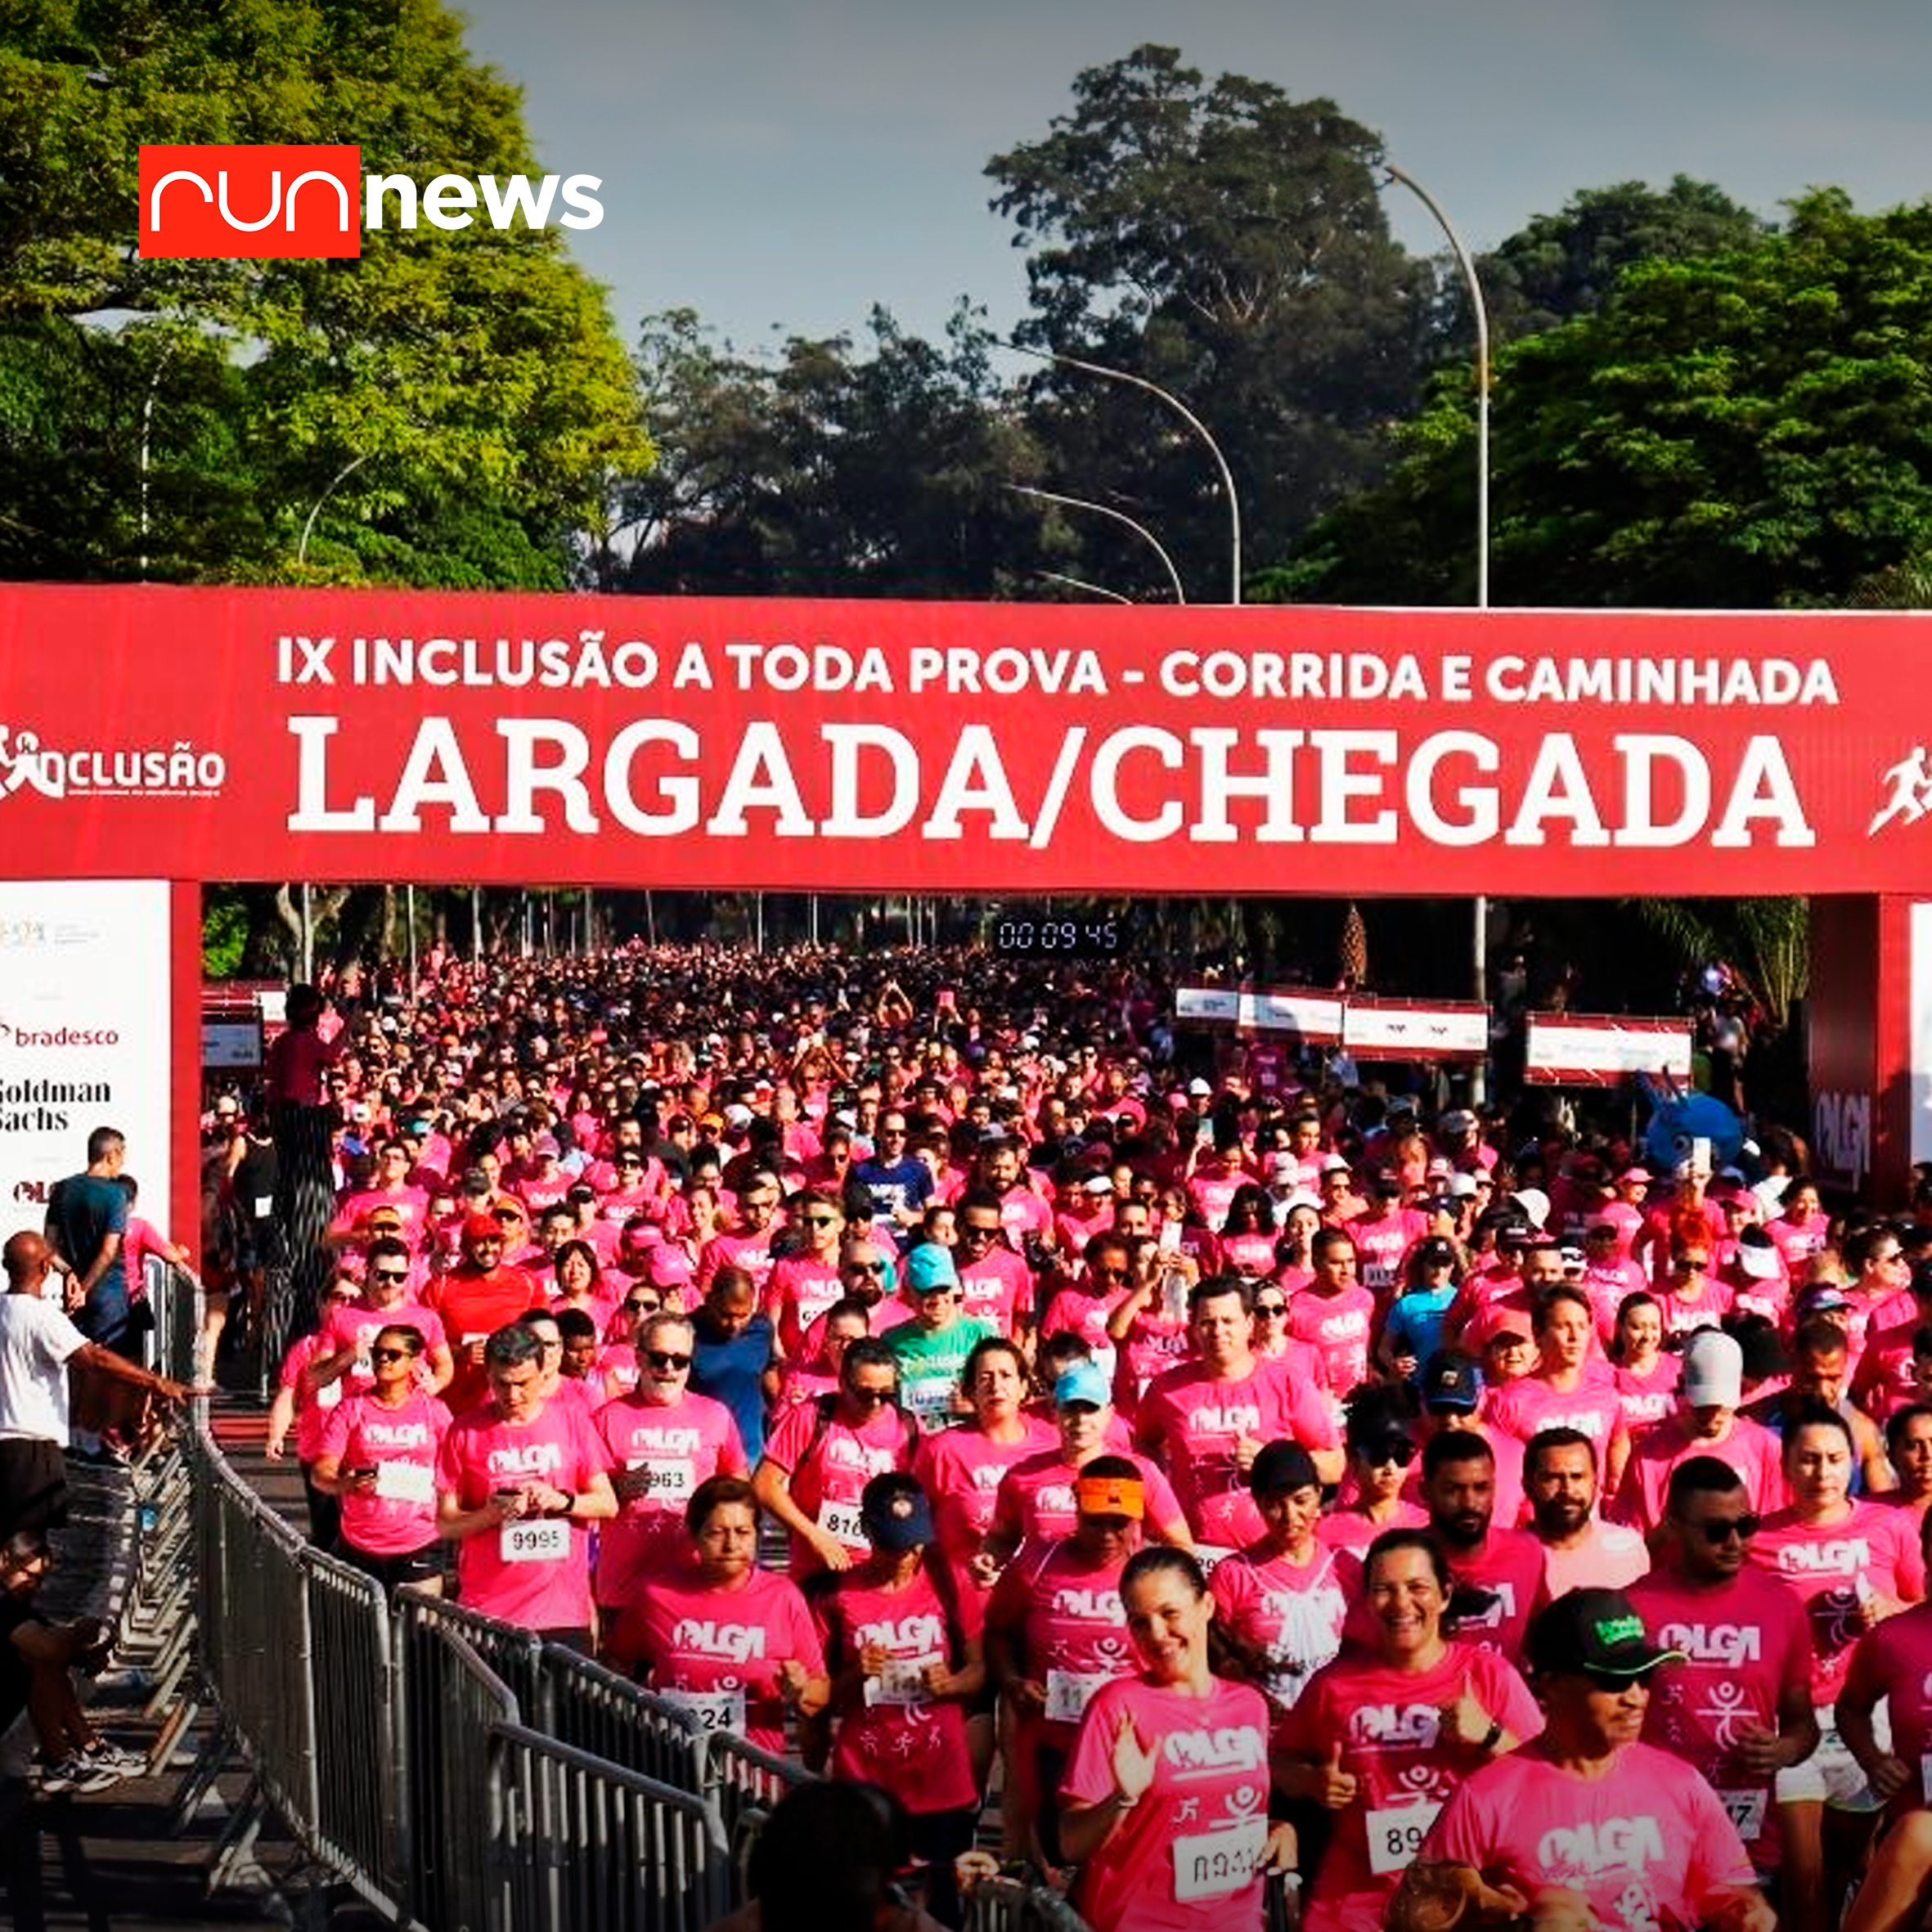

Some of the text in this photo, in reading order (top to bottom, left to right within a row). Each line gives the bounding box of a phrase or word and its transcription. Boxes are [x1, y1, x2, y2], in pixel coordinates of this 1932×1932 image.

[278, 636, 335, 684] IX
[353, 630, 658, 688] INCLUSÃO
[673, 643, 712, 689] A
[725, 644, 894, 693] TODA
[910, 647, 1108, 694] PROVA
[1160, 650, 1427, 700] CORRIDA
[1442, 655, 1472, 702] E
[1485, 655, 1840, 705] CAMINHADA
[287, 716, 1816, 850] LARGADA/CHEGADA
[16, 1027, 119, 1047] bradesco
[1778, 1538, 1871, 1575] OLGA
[672, 1619, 766, 1664] OLGA
[1658, 1623, 1760, 1669] OLGA
[1165, 1726, 1266, 1771] OLGA
[1538, 1816, 1665, 1881] OLGA
